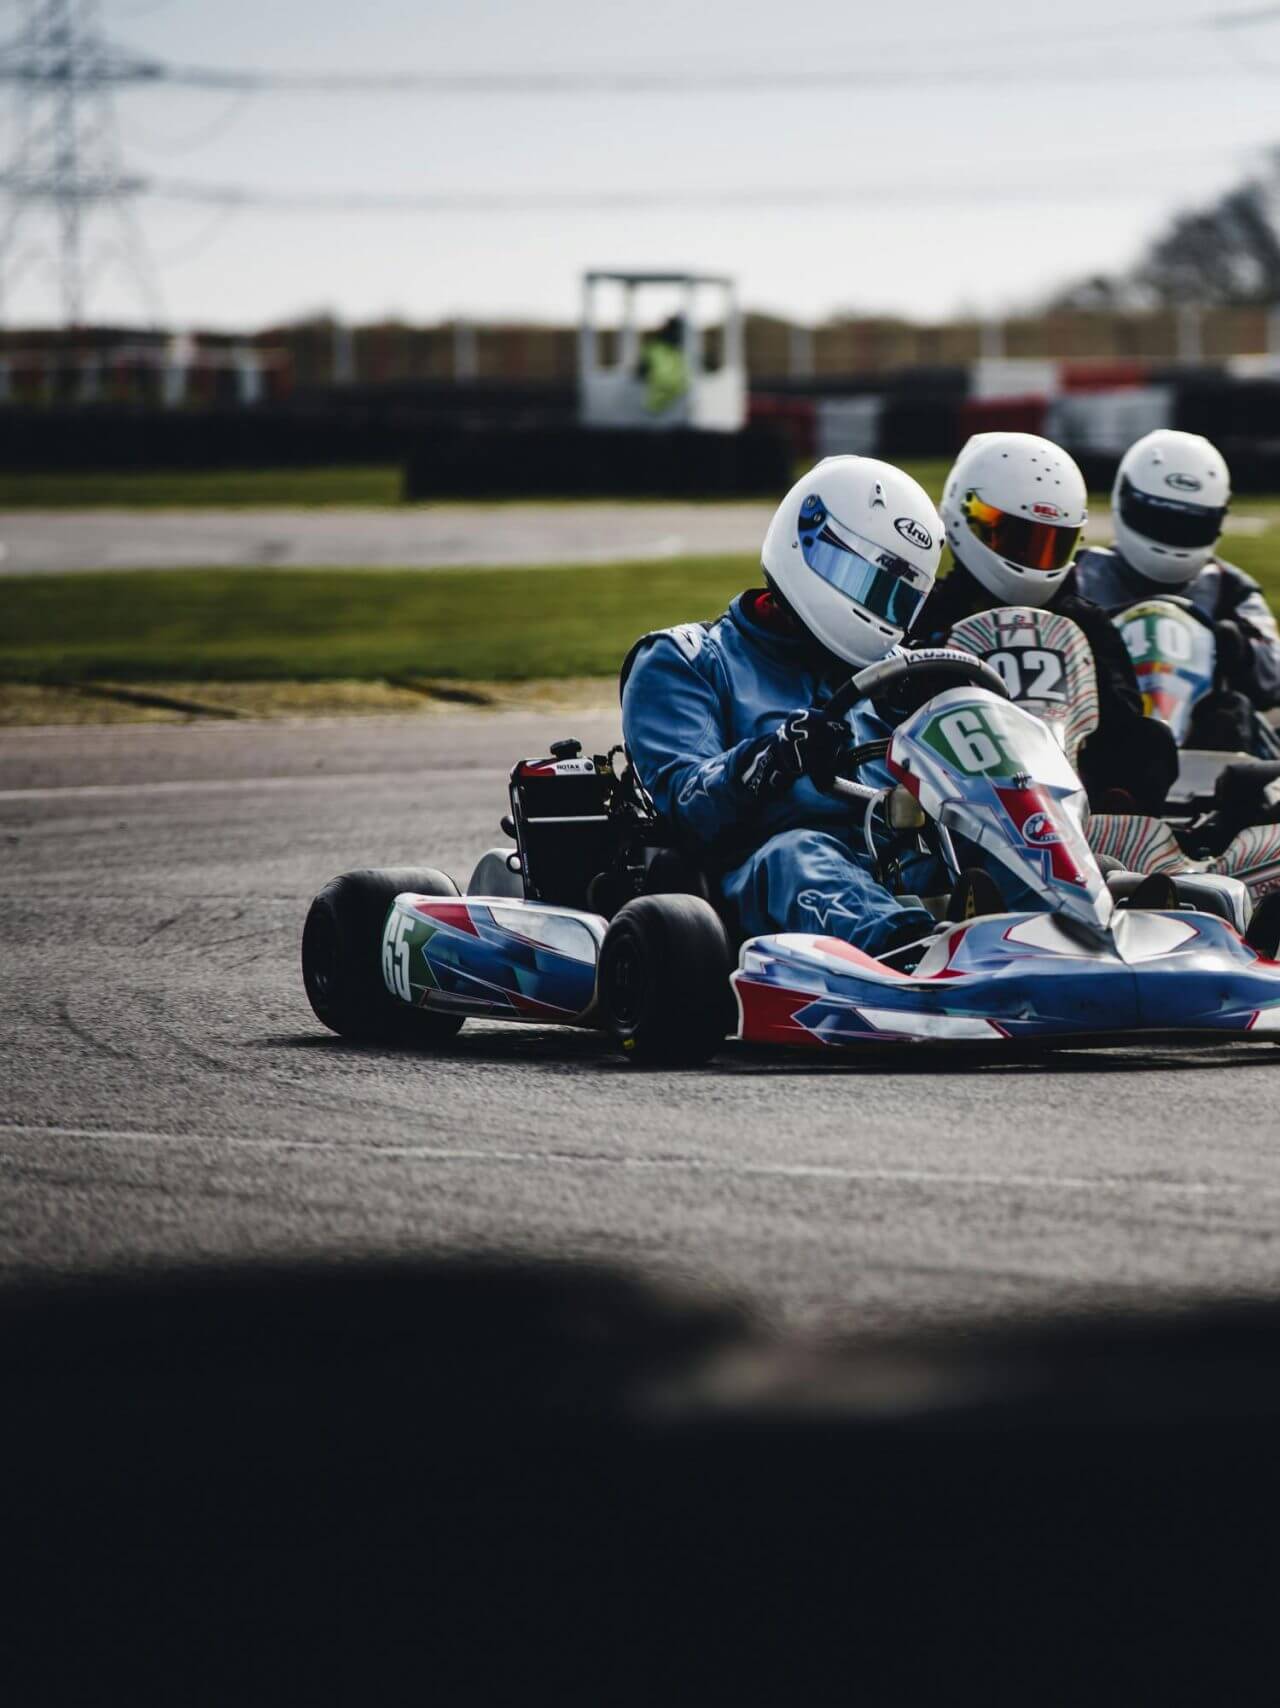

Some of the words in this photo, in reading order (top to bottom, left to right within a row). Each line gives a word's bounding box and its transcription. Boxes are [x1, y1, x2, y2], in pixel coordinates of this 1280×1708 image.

[1032, 504, 1059, 517] BELL
[902, 520, 930, 546] Arai
[382, 911, 415, 1002] 65
